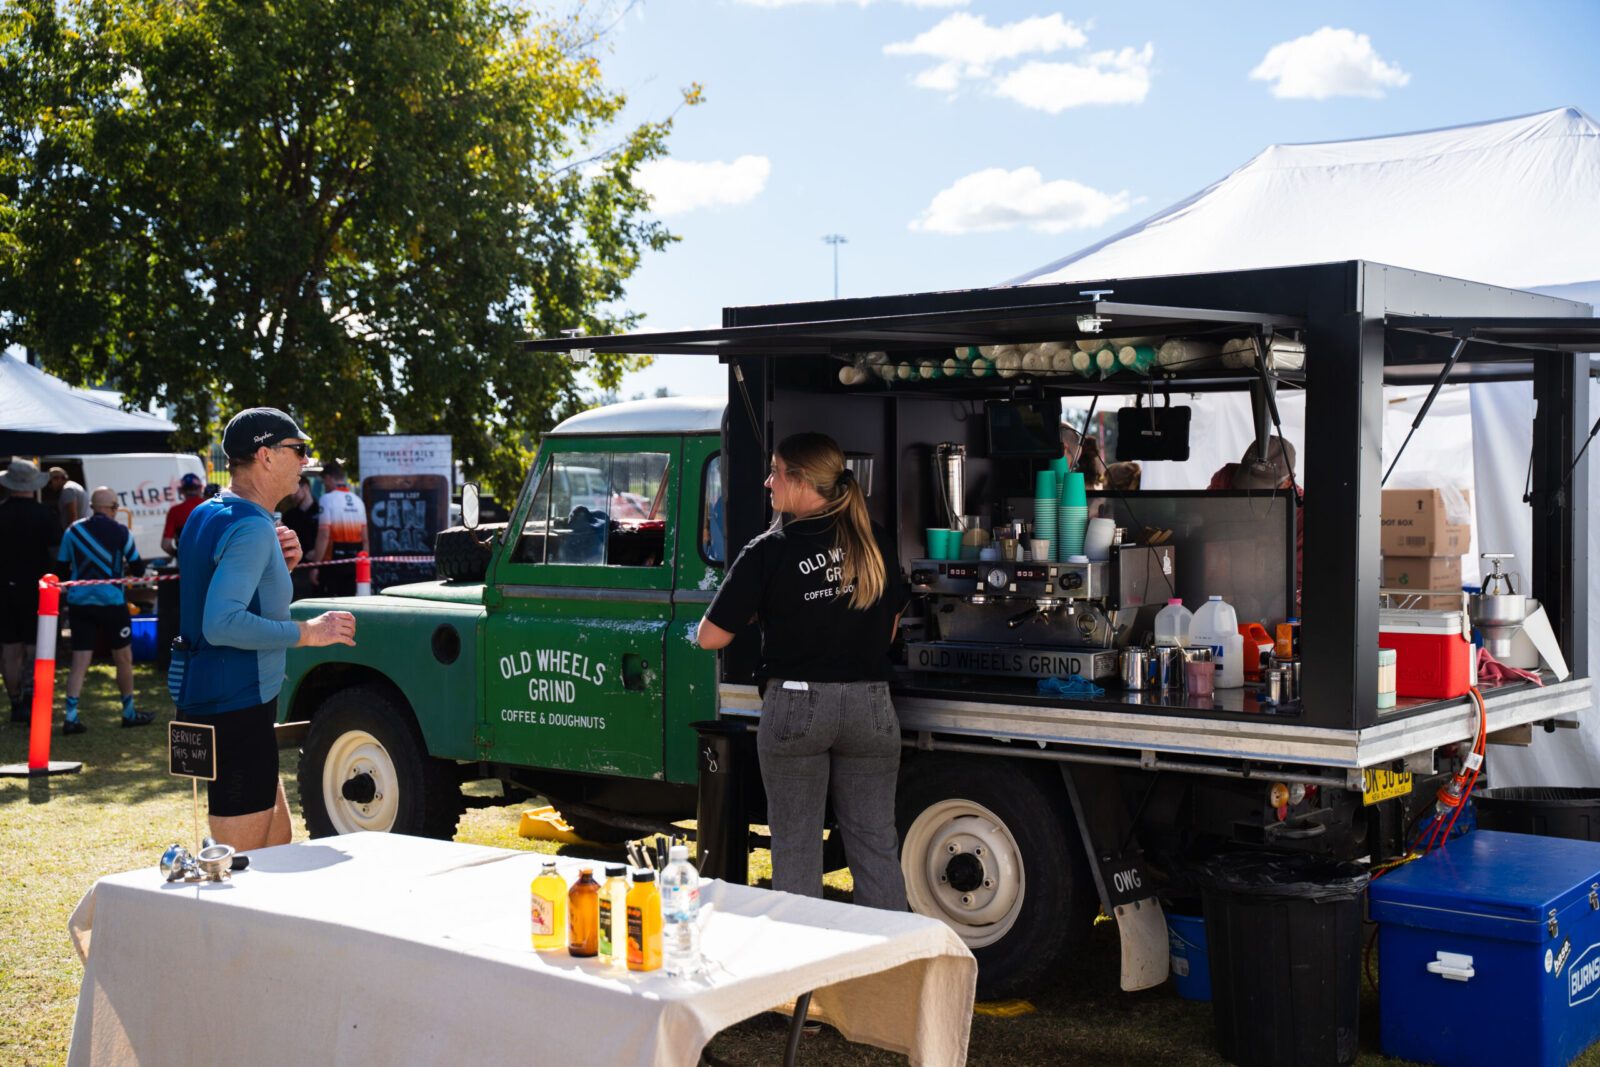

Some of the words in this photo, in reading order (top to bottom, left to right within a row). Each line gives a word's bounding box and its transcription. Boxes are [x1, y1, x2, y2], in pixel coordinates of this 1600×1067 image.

[371, 499, 426, 529] CAN
[798, 553, 827, 575] OLD
[804, 587, 834, 601] COFFEE
[500, 651, 532, 679] OLD
[536, 648, 606, 686] WHEELS
[919, 649, 949, 667] OLD
[955, 651, 1023, 672] WHEELS
[1029, 655, 1081, 674] GRIND
[528, 678, 576, 703] GRIND
[501, 709, 537, 723] COFFEE
[540, 712, 546, 724] &
[548, 713, 606, 729] DOUGHNUTS
[171, 728, 202, 746] SERVICE
[172, 746, 188, 760] THIS
[191, 749, 207, 760] WAY
[1113, 868, 1142, 893] OWG
